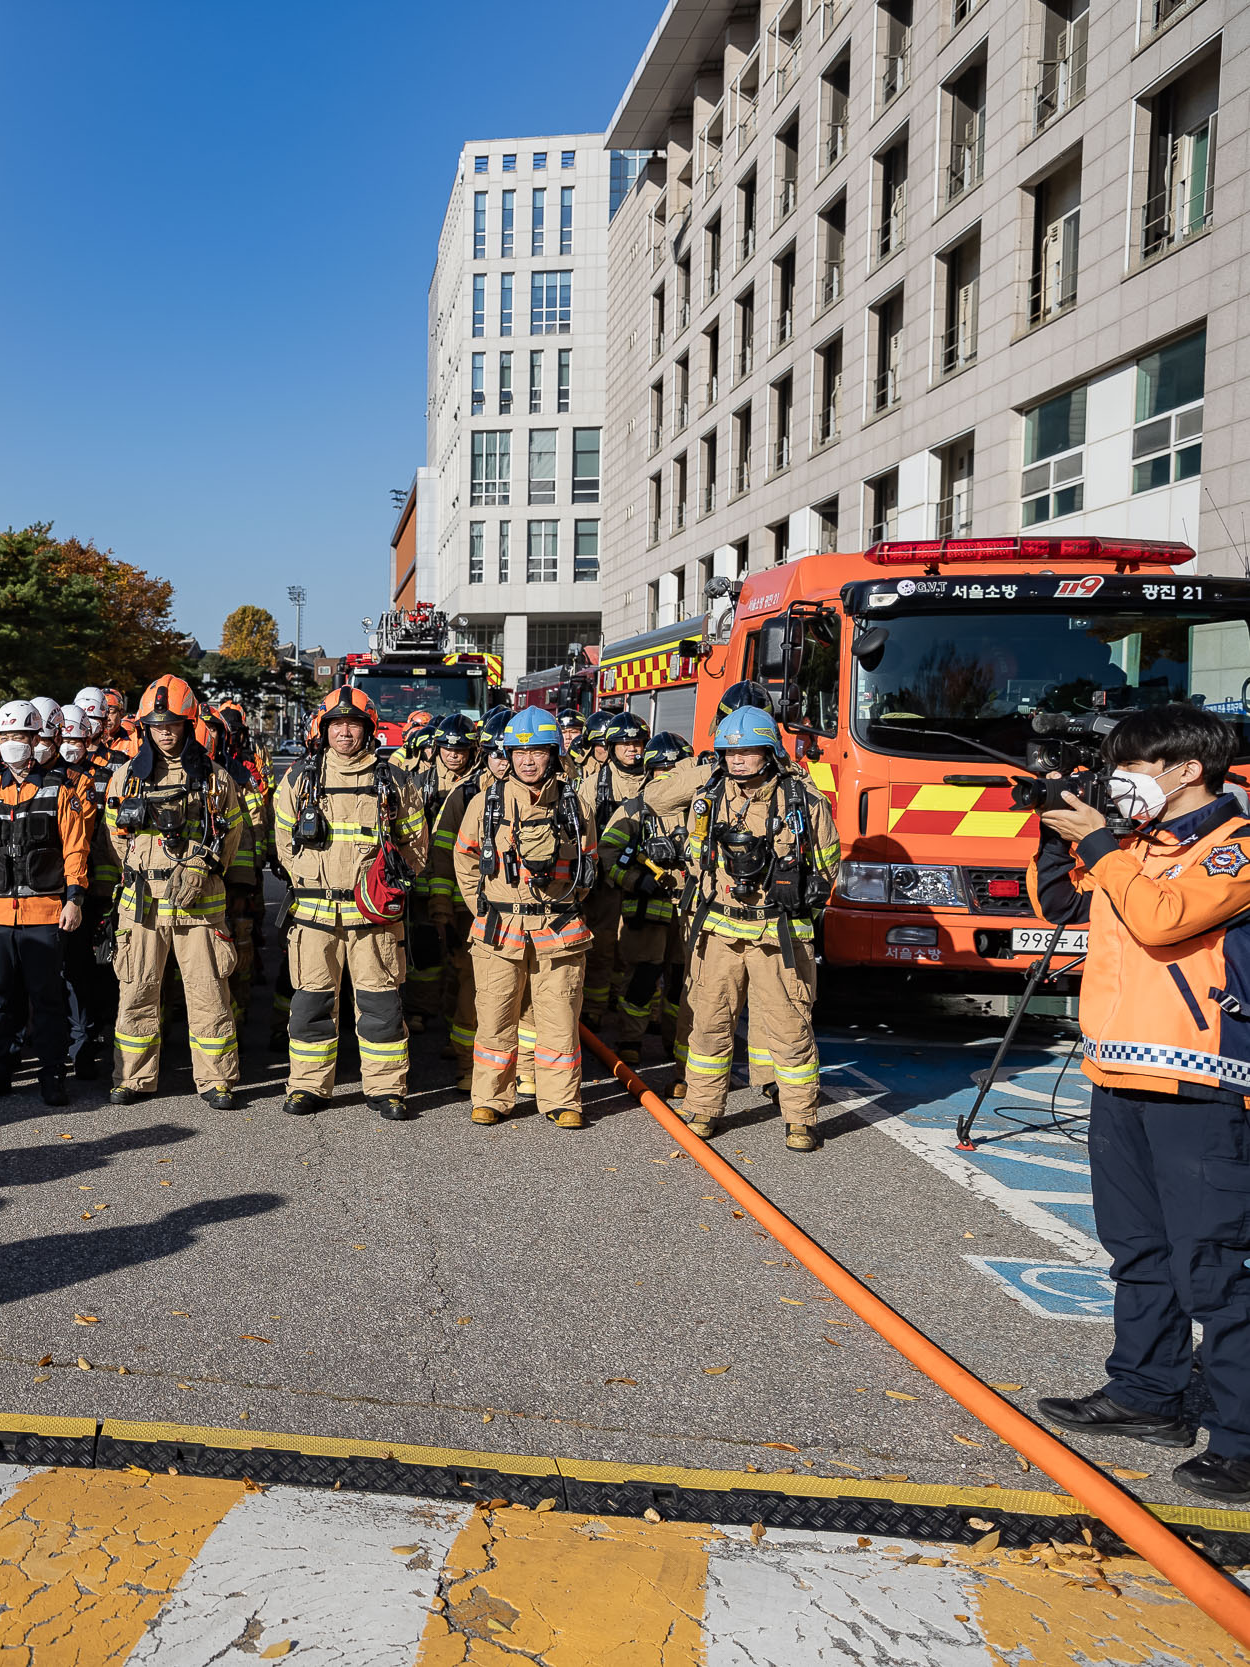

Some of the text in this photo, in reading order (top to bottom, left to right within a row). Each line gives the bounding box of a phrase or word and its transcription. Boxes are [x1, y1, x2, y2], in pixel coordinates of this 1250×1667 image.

[951, 576, 1203, 600] 서울소방 119 광진 21
[886, 947, 942, 961] 서울소방
